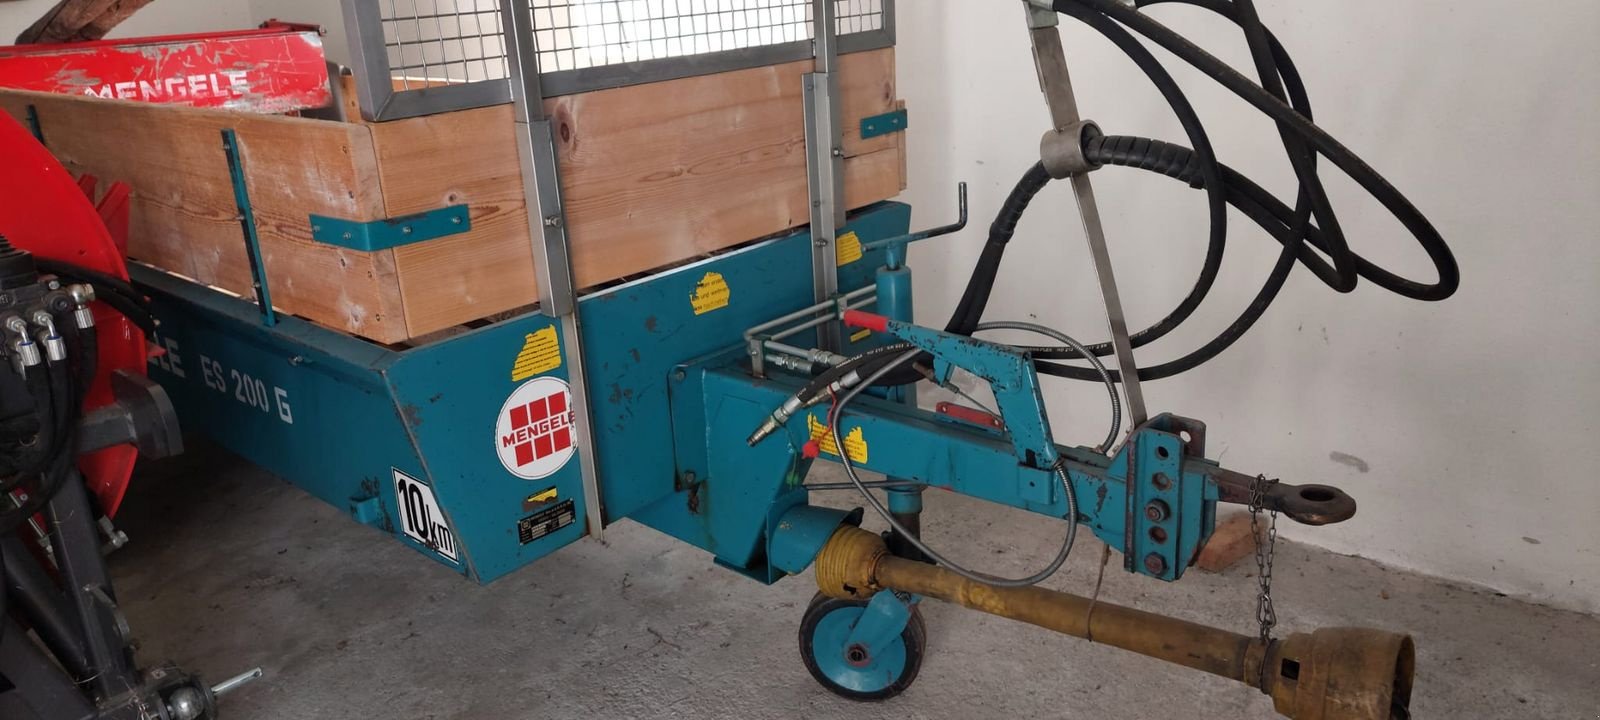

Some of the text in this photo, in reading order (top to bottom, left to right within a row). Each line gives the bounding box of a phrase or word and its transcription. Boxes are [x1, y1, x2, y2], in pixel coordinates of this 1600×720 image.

[84, 71, 250, 100] MENGELE
[200, 354, 226, 393] ES
[231, 368, 270, 413] 200
[274, 386, 293, 425] G
[502, 410, 575, 448] MENGELE
